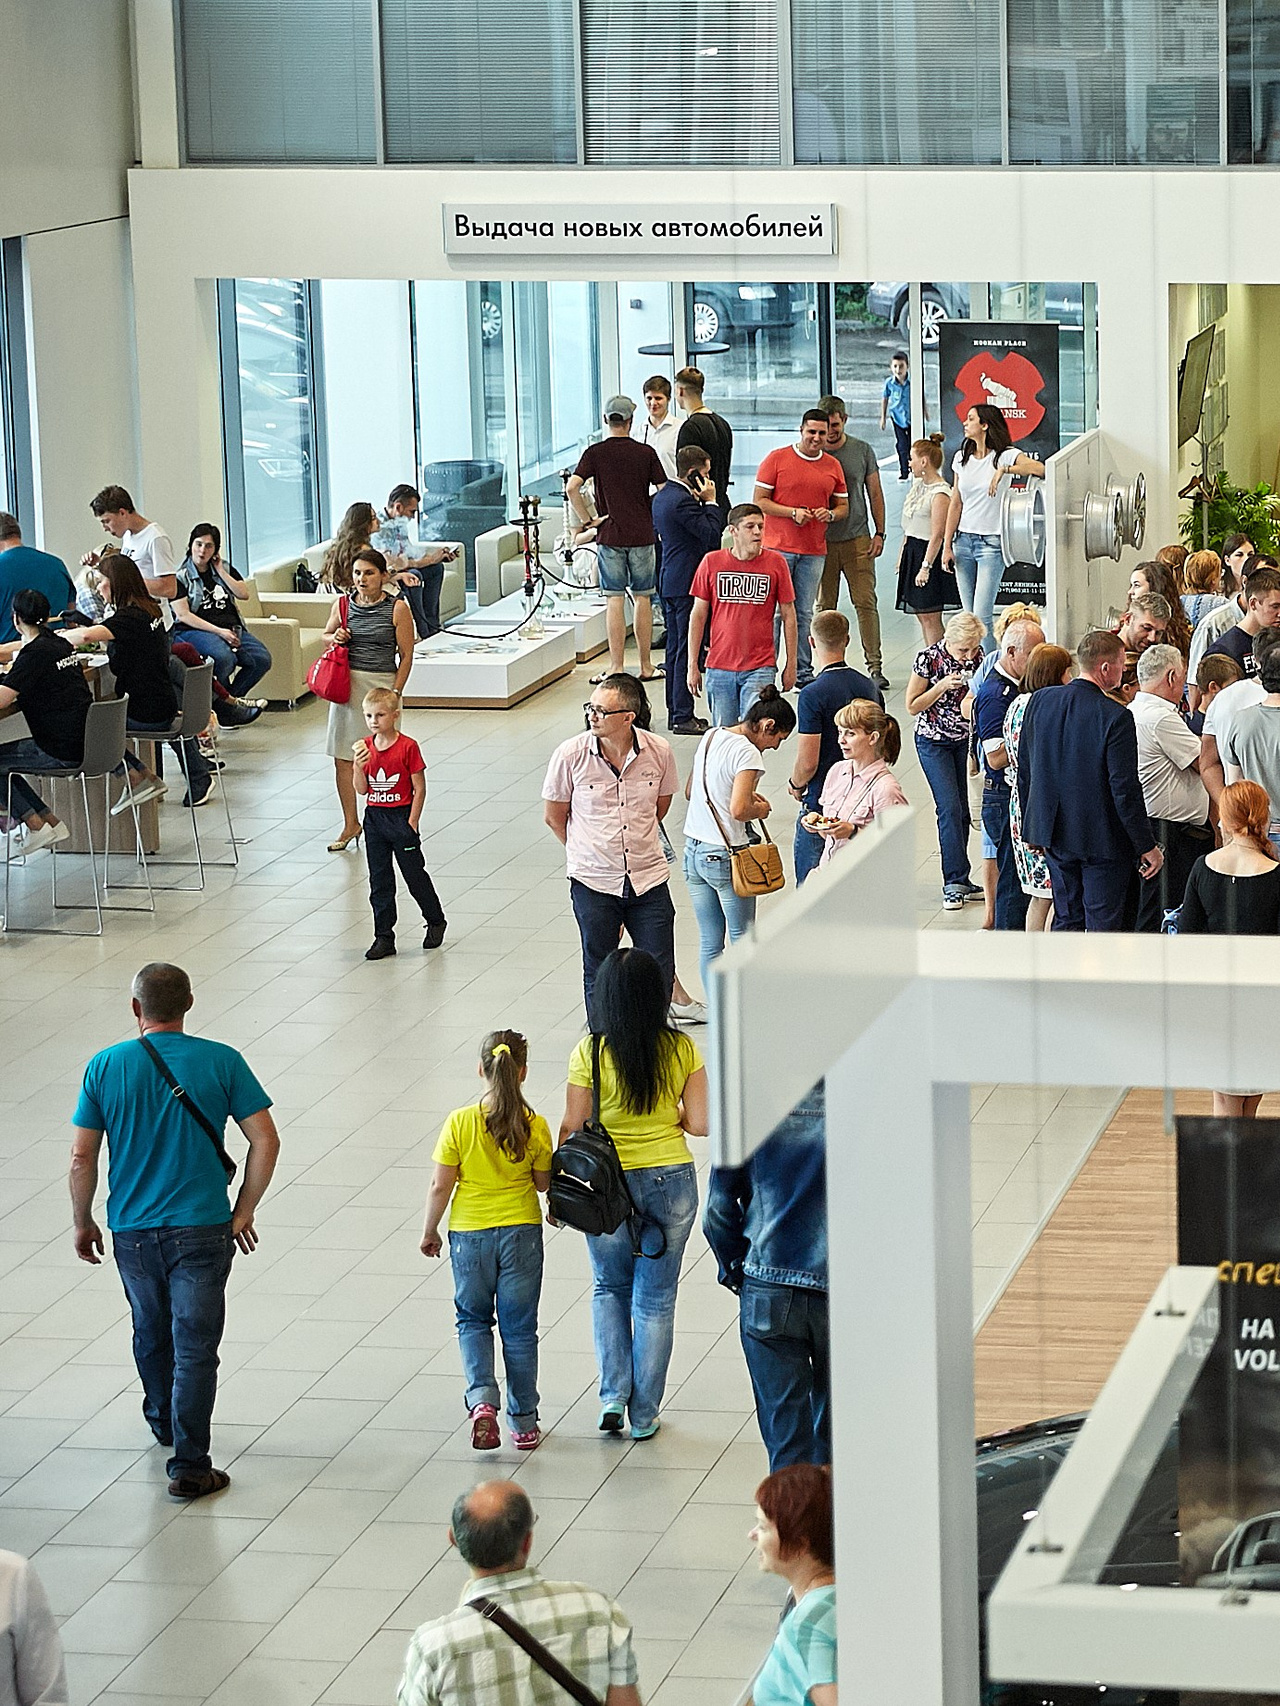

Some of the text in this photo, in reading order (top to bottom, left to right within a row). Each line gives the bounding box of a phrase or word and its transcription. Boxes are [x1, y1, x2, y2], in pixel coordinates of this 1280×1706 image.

[454, 213, 824, 240] Выдача новых автомобилей
[719, 574, 768, 599] TRUE
[368, 792, 401, 803] adidas
[1241, 1318, 1275, 1340] НА
